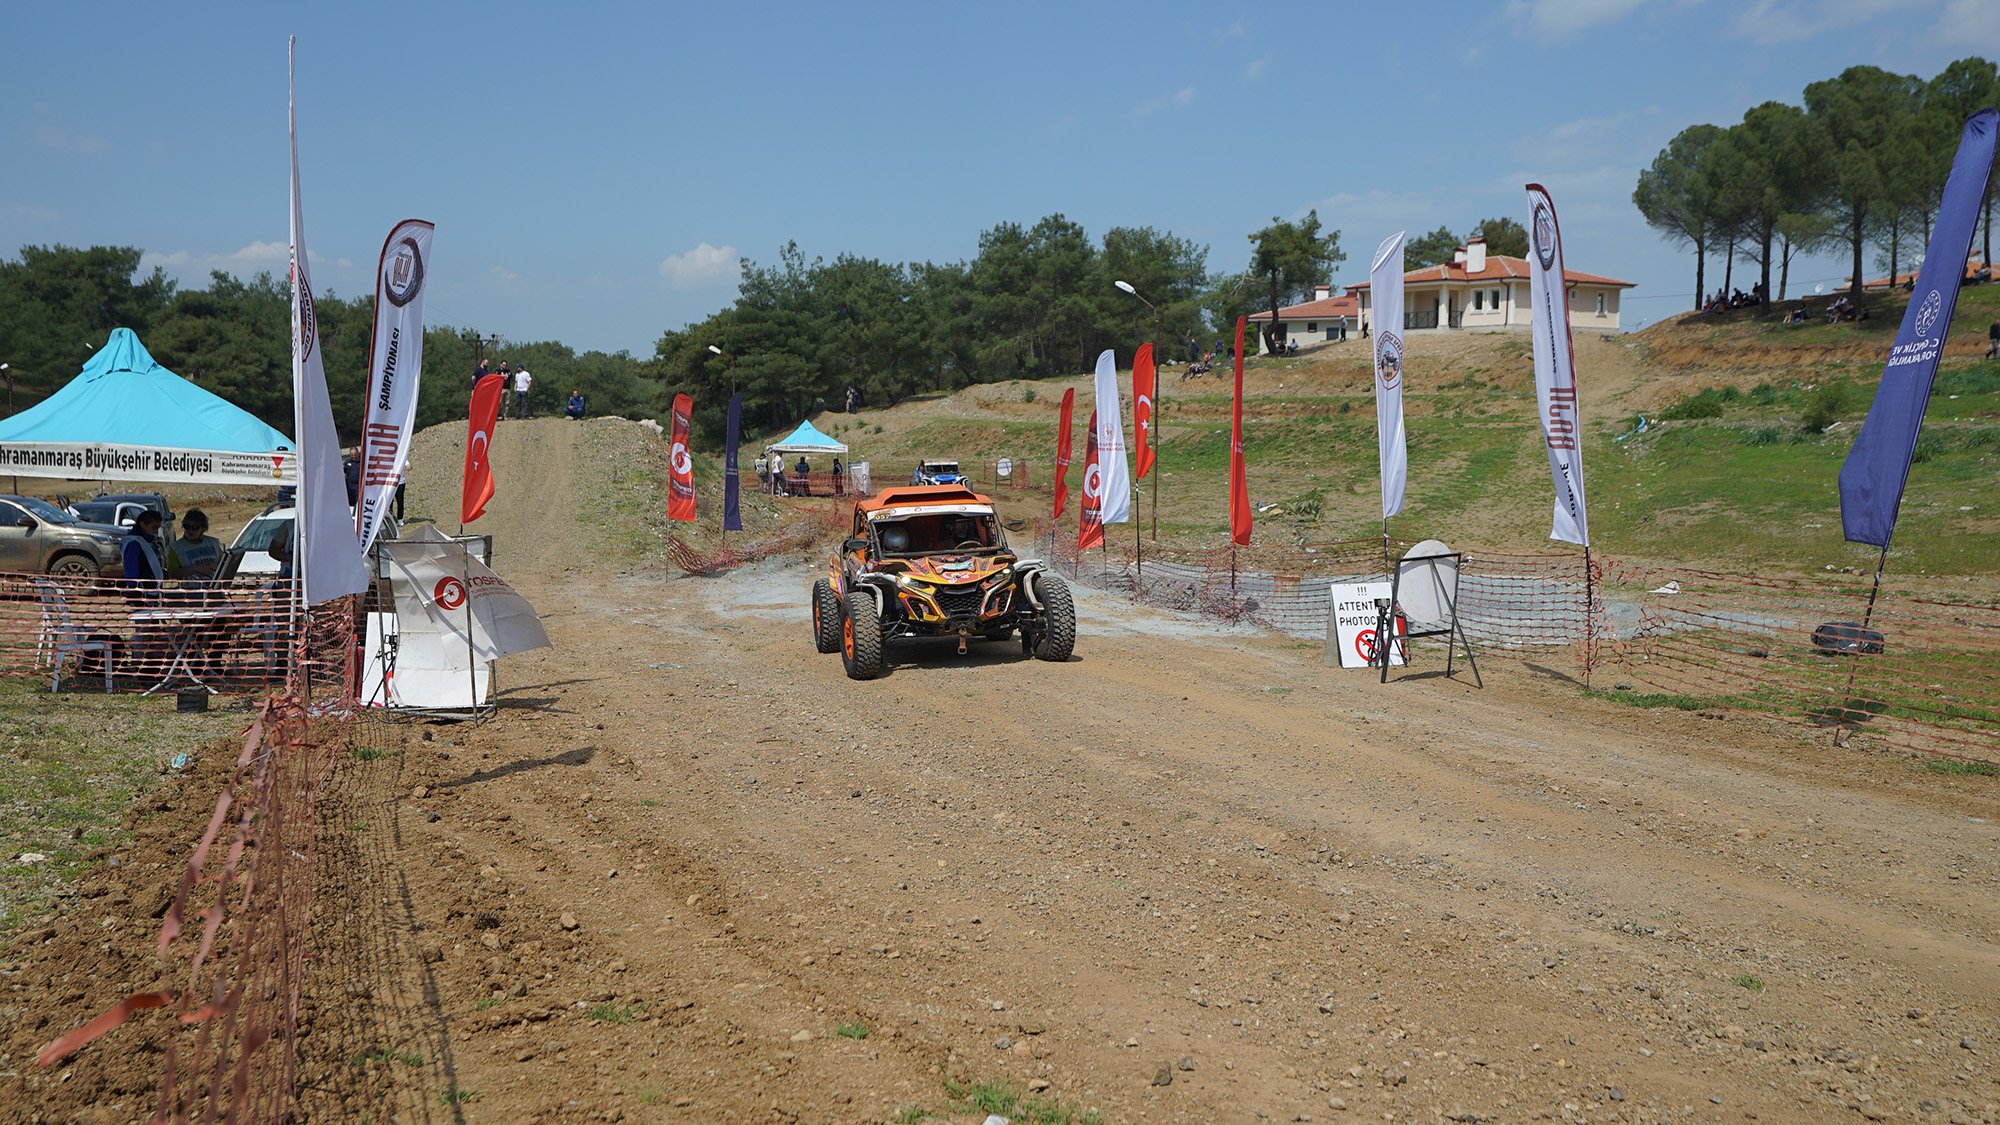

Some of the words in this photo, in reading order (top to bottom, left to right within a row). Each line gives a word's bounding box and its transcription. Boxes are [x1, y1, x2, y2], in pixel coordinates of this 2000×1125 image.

[378, 327, 400, 411] ŞAMPİYONASI
[85, 448, 151, 473] Büyükşehir
[154, 451, 212, 476] Belediyesi
